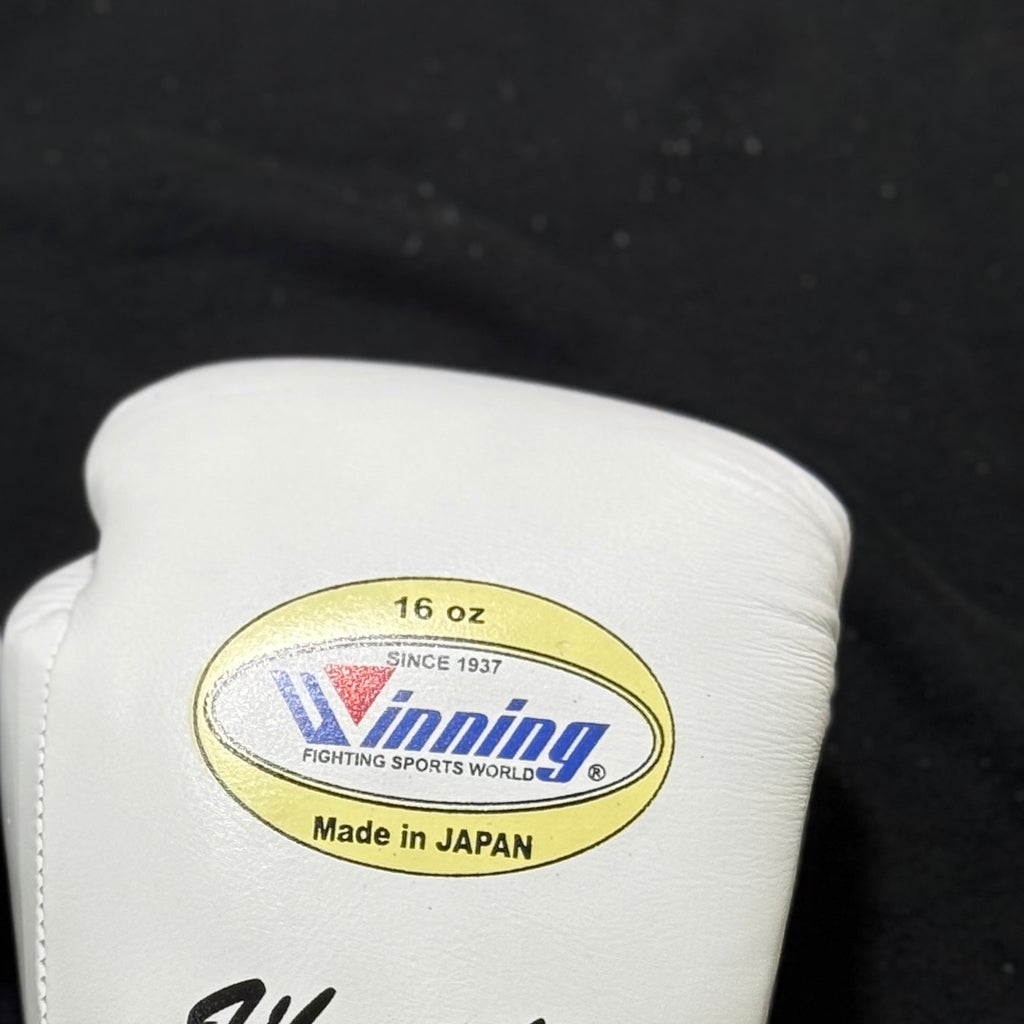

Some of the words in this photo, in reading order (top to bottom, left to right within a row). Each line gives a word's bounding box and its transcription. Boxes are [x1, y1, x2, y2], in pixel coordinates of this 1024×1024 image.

[394, 596, 433, 620] 16
[447, 604, 486, 624] oz
[387, 651, 450, 671] SINCE
[458, 657, 503, 675] 1937
[270, 663, 610, 784] Winning
[302, 747, 386, 768] FIGHTING
[391, 755, 464, 776] SPORTS
[469, 763, 535, 782] WORLD
[313, 815, 391, 848] Made
[401, 824, 426, 850] in
[436, 827, 533, 860] JAPAN
